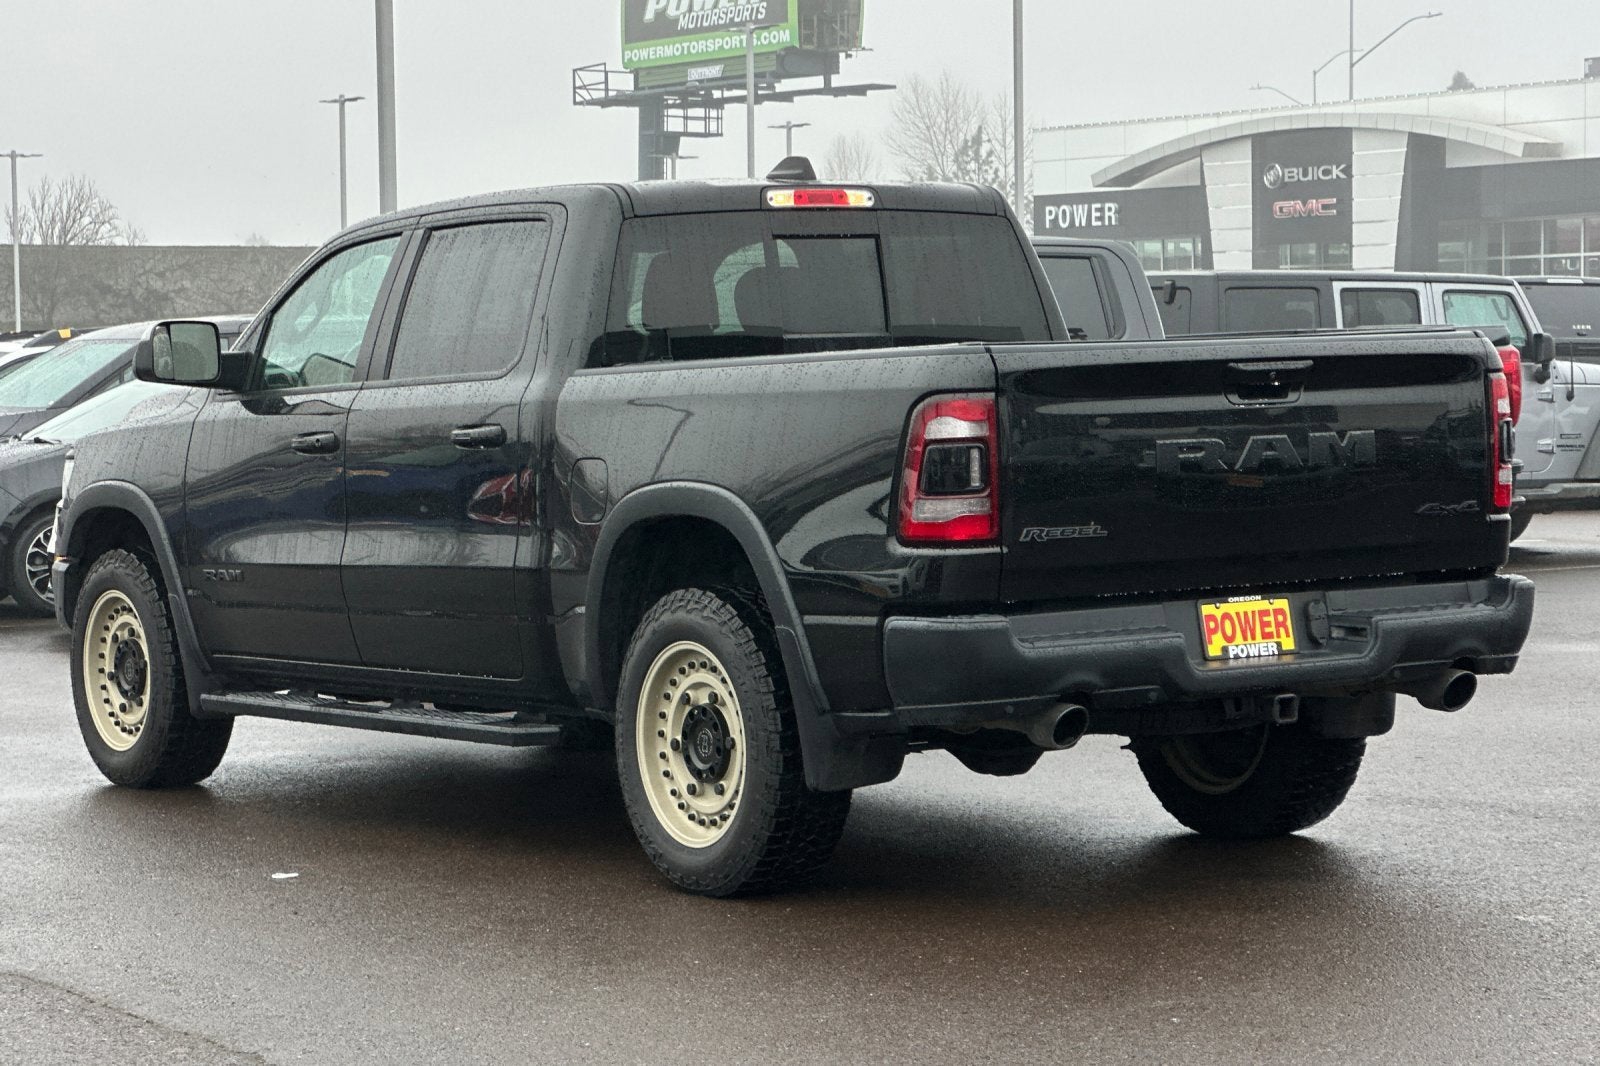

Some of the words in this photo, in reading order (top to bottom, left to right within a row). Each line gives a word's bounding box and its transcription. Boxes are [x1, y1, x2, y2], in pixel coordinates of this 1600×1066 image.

[677, 1, 768, 30] MOTORSPORTS
[1284, 164, 1348, 183] BUICK
[1045, 202, 1119, 229] POWER
[1273, 198, 1337, 218] GMC
[1155, 430, 1377, 474] RAM
[202, 568, 243, 582] RAM
[1227, 594, 1262, 603] OREGON
[1204, 608, 1291, 645] POWER
[1228, 642, 1279, 659] POWER
